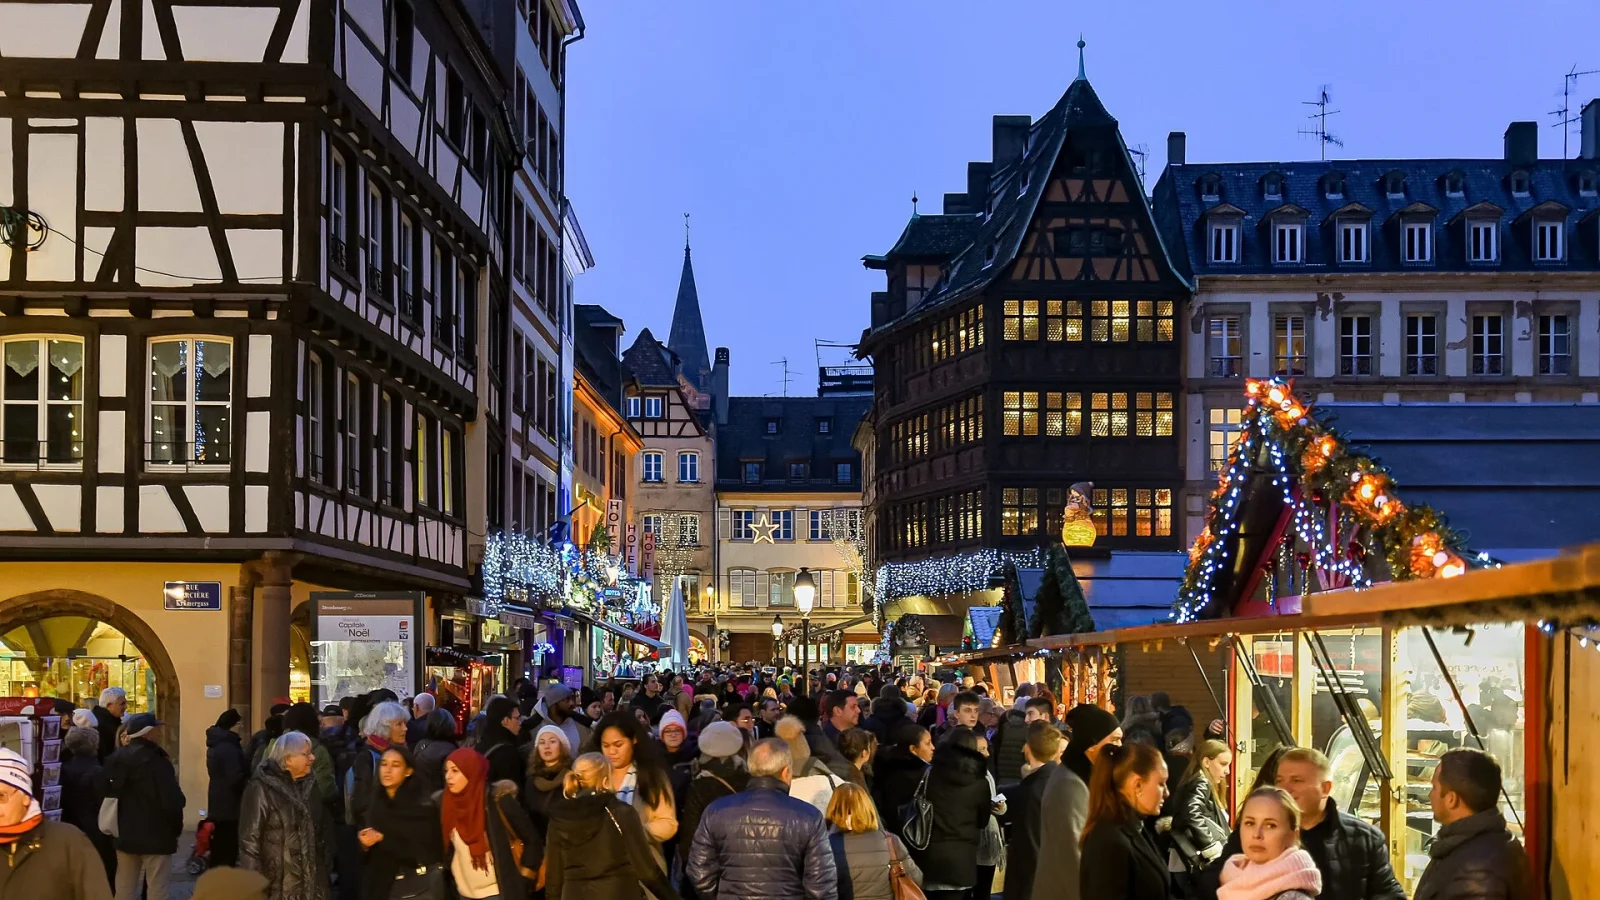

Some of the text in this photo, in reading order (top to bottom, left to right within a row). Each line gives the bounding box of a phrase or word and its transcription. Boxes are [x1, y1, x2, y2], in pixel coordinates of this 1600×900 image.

[608, 501, 619, 556] HOTEL
[627, 524, 636, 574] HOTEL
[338, 621, 365, 629] Capitale
[348, 628, 370, 637] Noël
